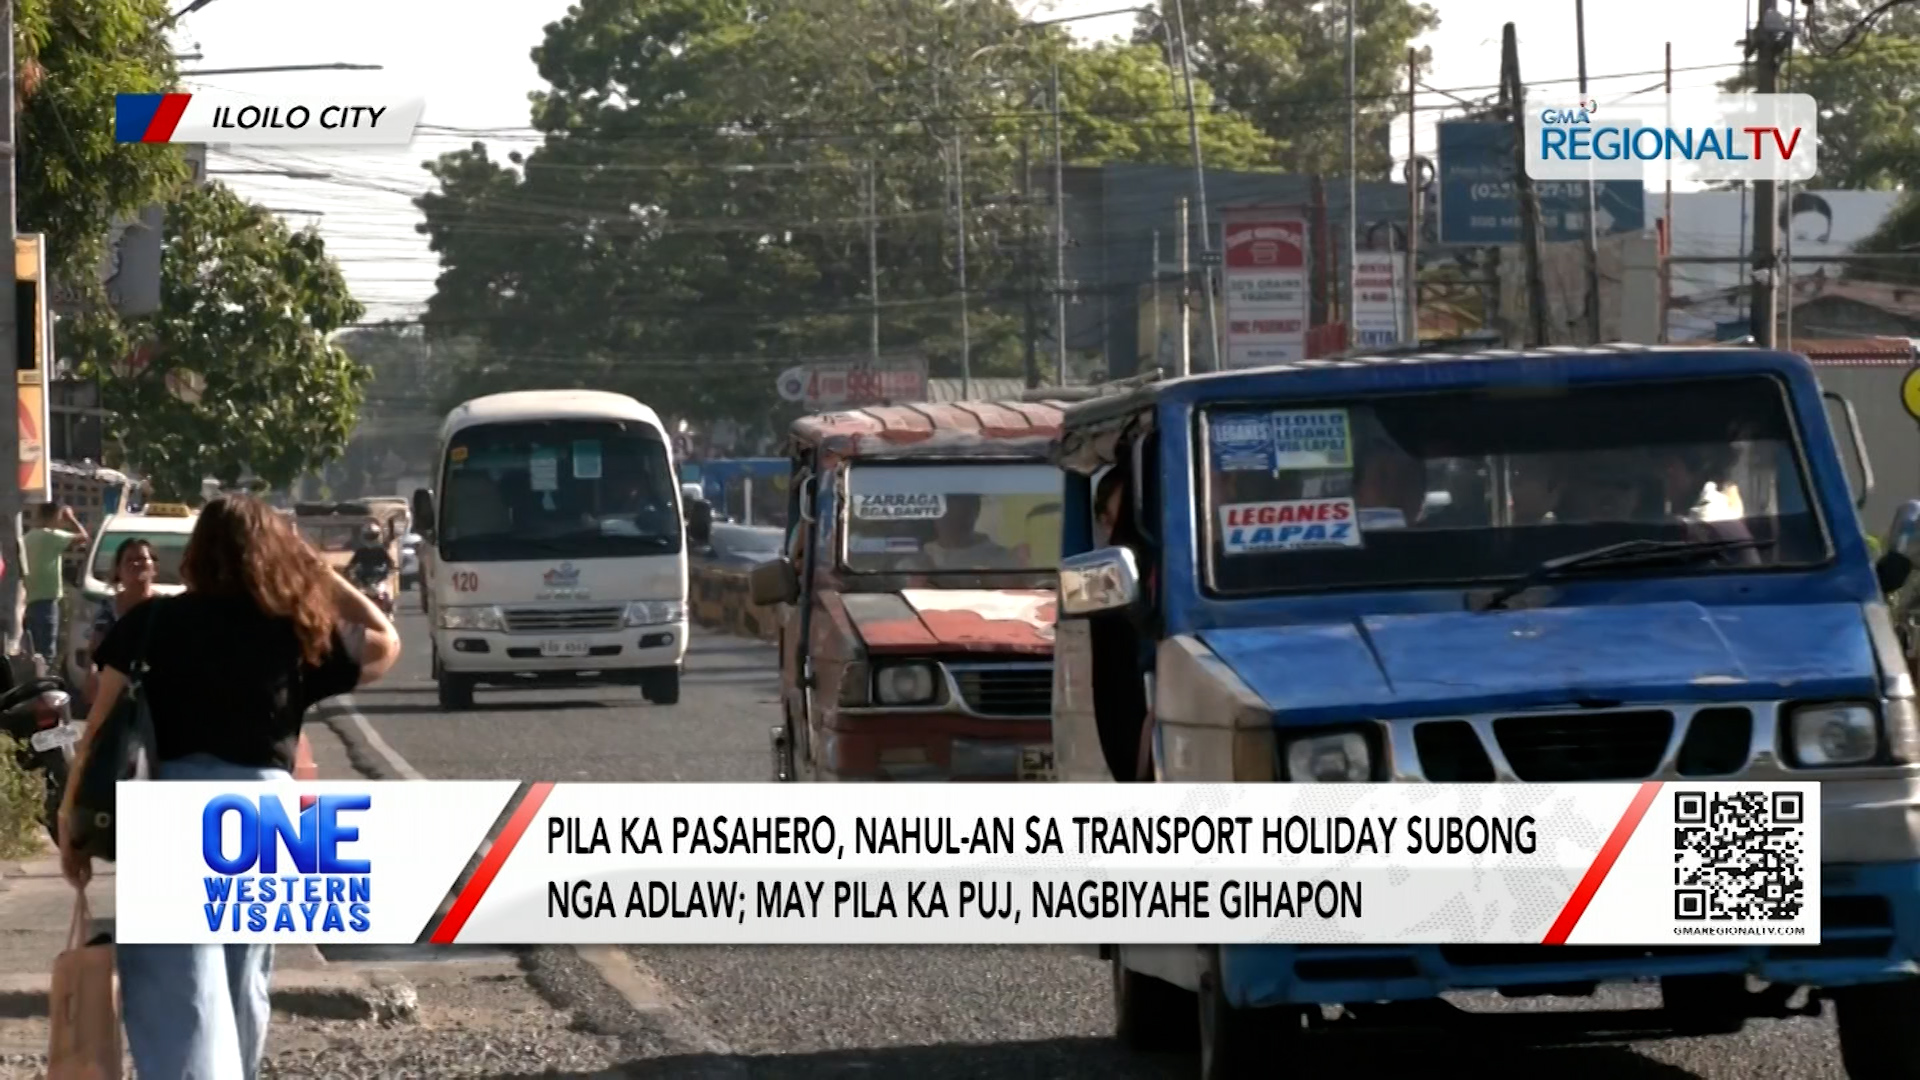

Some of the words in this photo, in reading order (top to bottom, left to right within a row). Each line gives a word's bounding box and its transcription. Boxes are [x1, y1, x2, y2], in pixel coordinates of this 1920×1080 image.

[861, 494, 939, 506] ZARRAGA
[1227, 502, 1350, 526] LEGANES
[1229, 523, 1352, 544] LAPAZ
[451, 570, 479, 593] 120
